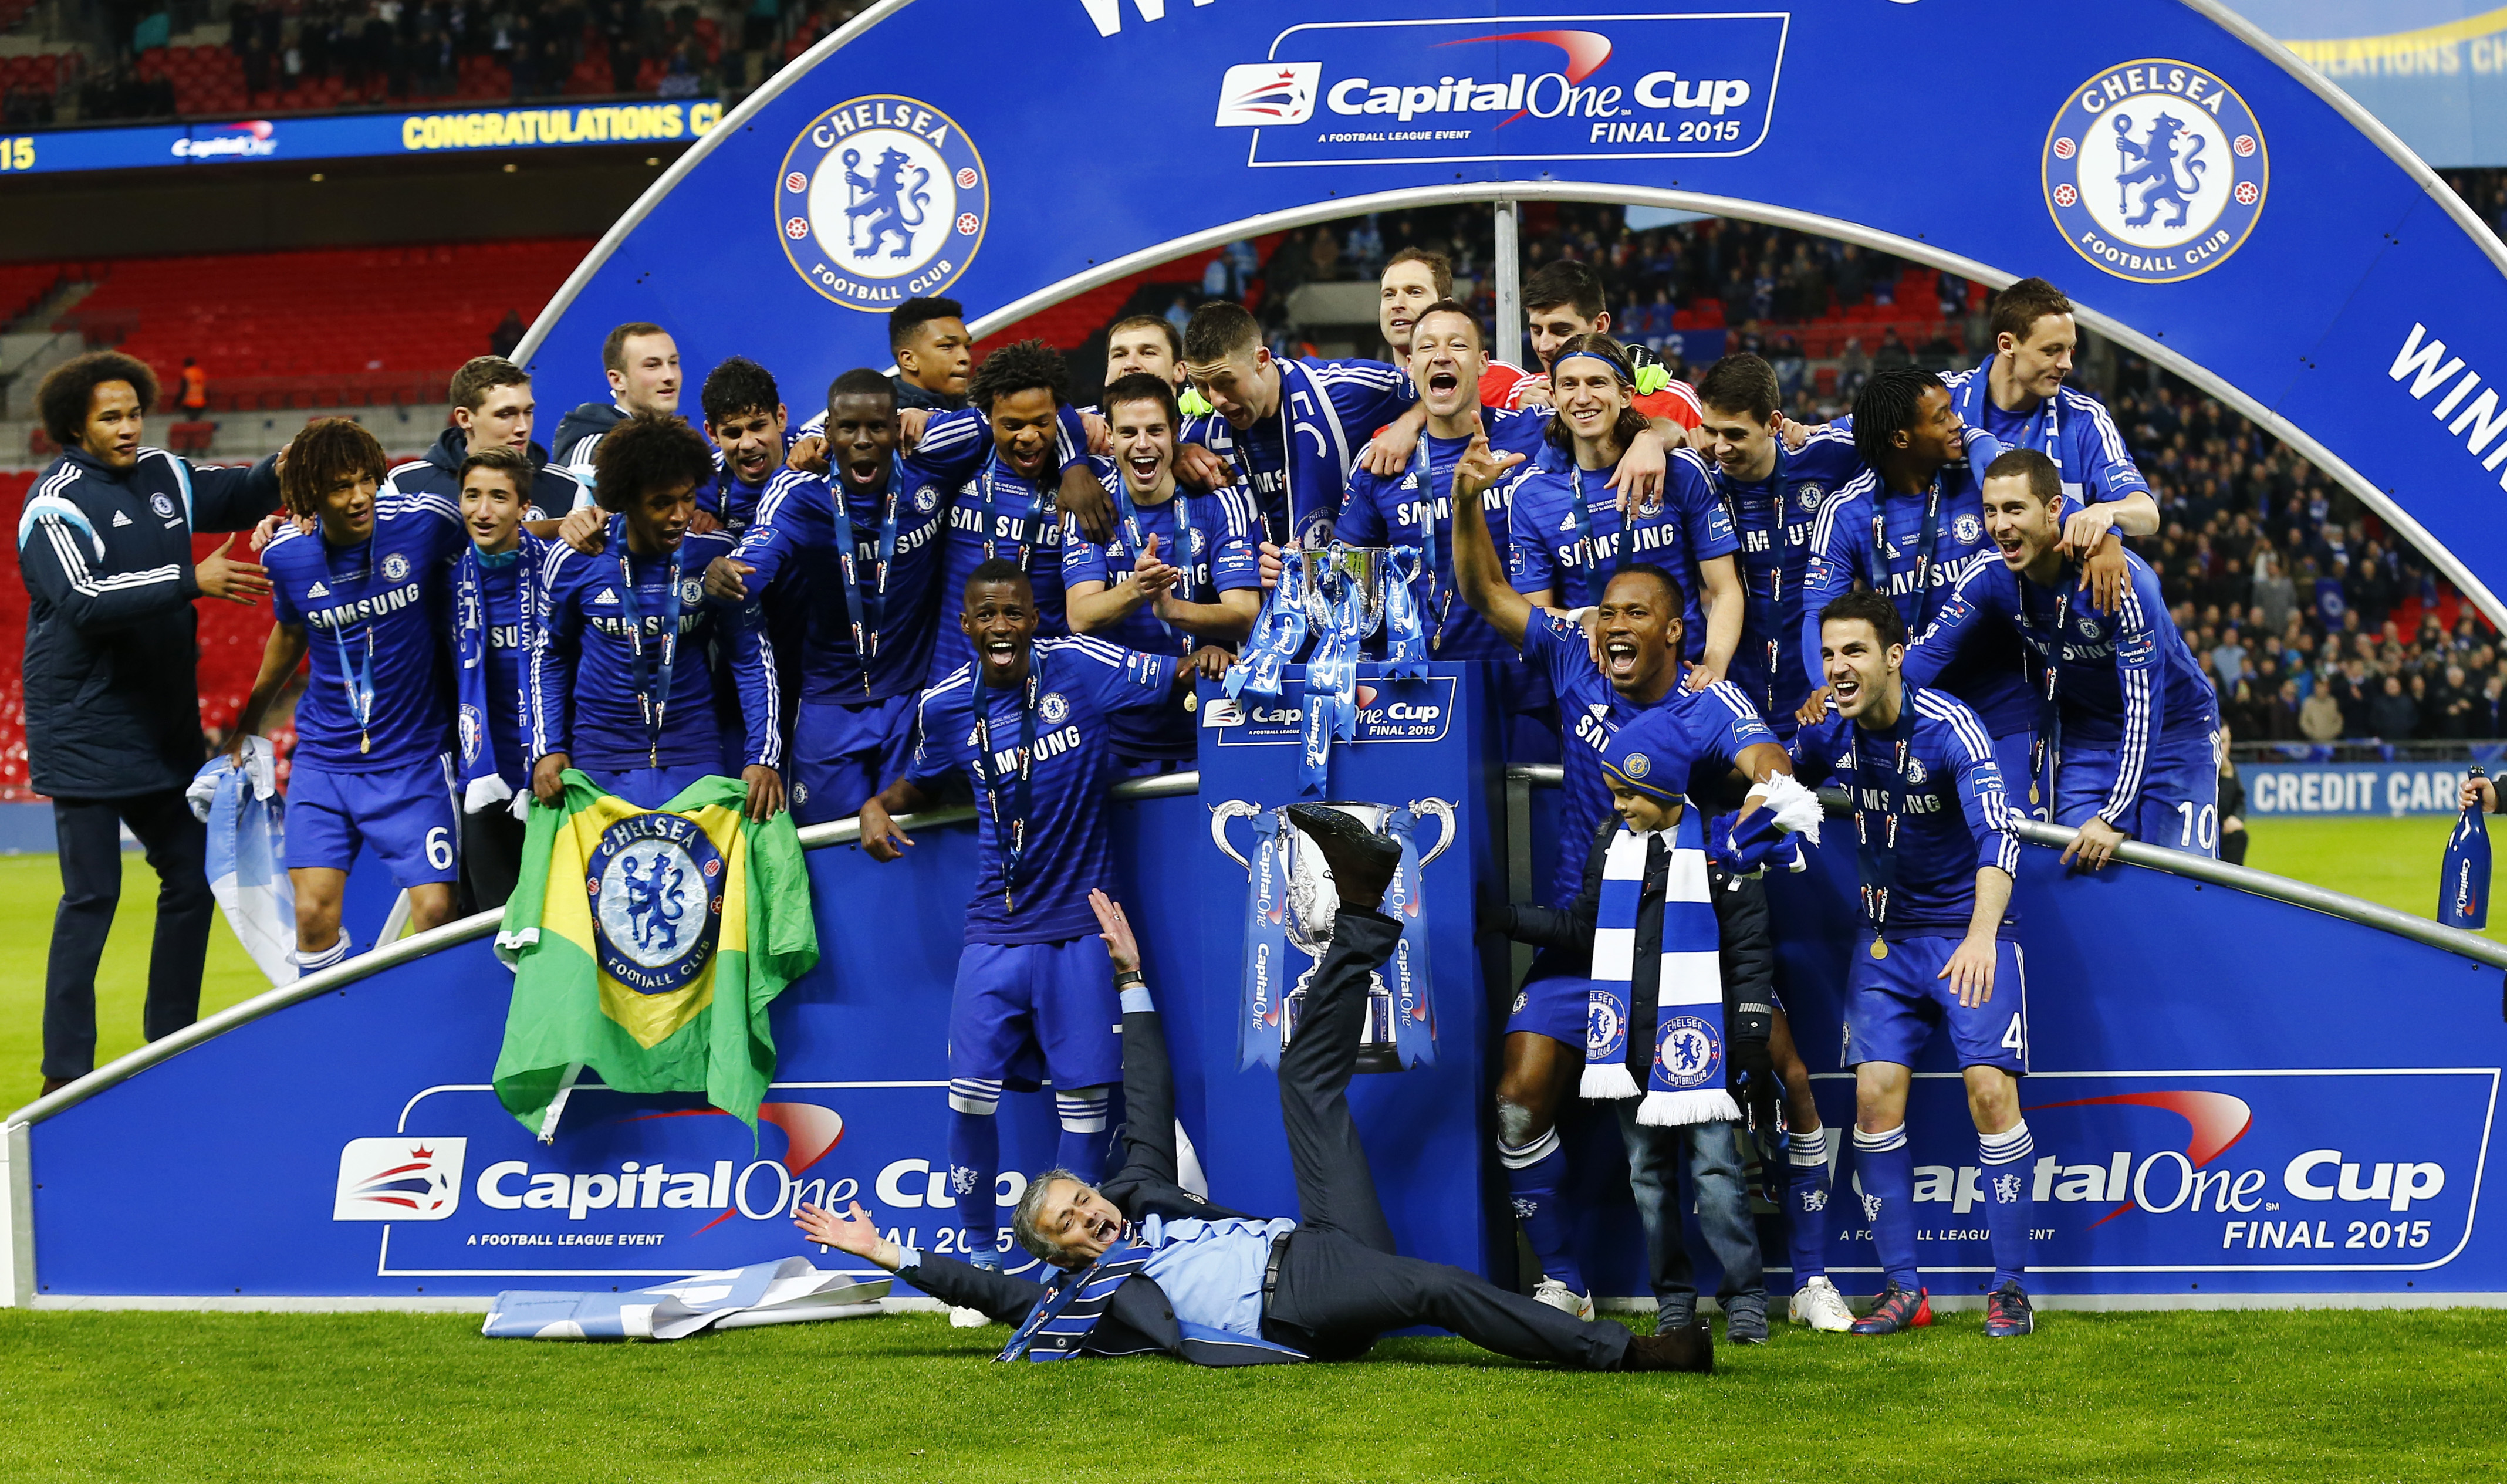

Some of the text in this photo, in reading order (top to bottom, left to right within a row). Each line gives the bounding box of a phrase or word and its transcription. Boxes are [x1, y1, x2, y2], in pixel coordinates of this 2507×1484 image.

[1326, 72, 1622, 121] CapitalOne
[1634, 71, 1751, 115] Cup
[2082, 67, 2226, 114] CHELSEA
[403, 104, 684, 150] CONGRATULATIONS
[812, 103, 950, 150] CHELSEA
[1318, 130, 1471, 143] A FOOTBALL LEAGUE EVENT
[1590, 120, 1741, 143] FINAL 2015
[2081, 229, 2230, 271] FOOTBALL CLUB
[812, 259, 952, 301] FOOTBALL CLUB
[1066, 557, 1079, 566] Cup
[308, 583, 419, 628] SAMSUNG
[1149, 661, 1158, 675] Cup
[1312, 633, 1336, 691] CapitalOne
[1028, 675, 1038, 709] CapitalOne
[1387, 702, 1440, 721] Cup
[1306, 696, 1323, 770] CapitalOne
[1369, 725, 1436, 736] FINAL 2015
[1897, 738, 1908, 775] CapitalOne
[1987, 782, 2002, 790] Cup
[2253, 772, 2378, 812] CREDIT
[2177, 800, 2215, 850] 10
[425, 826, 454, 870] 6
[1256, 840, 1273, 929] CapitalOne
[2455, 858, 2471, 918] CapitalOne
[1252, 942, 1269, 1032] CapitalOne
[1397, 937, 1413, 1029] CapitalOne
[1667, 1018, 1702, 1032] CHELSEA
[2001, 1012, 2023, 1059] 4
[1853, 1151, 2265, 1213] aptalOne
[2283, 1149, 2445, 1211] Cup
[467, 1234, 664, 1246] A FOOTBALL LEAGUE EVENT
[1840, 1229, 1989, 1241] A LEAGU
[2222, 1221, 2431, 1249] FINAL 2015
